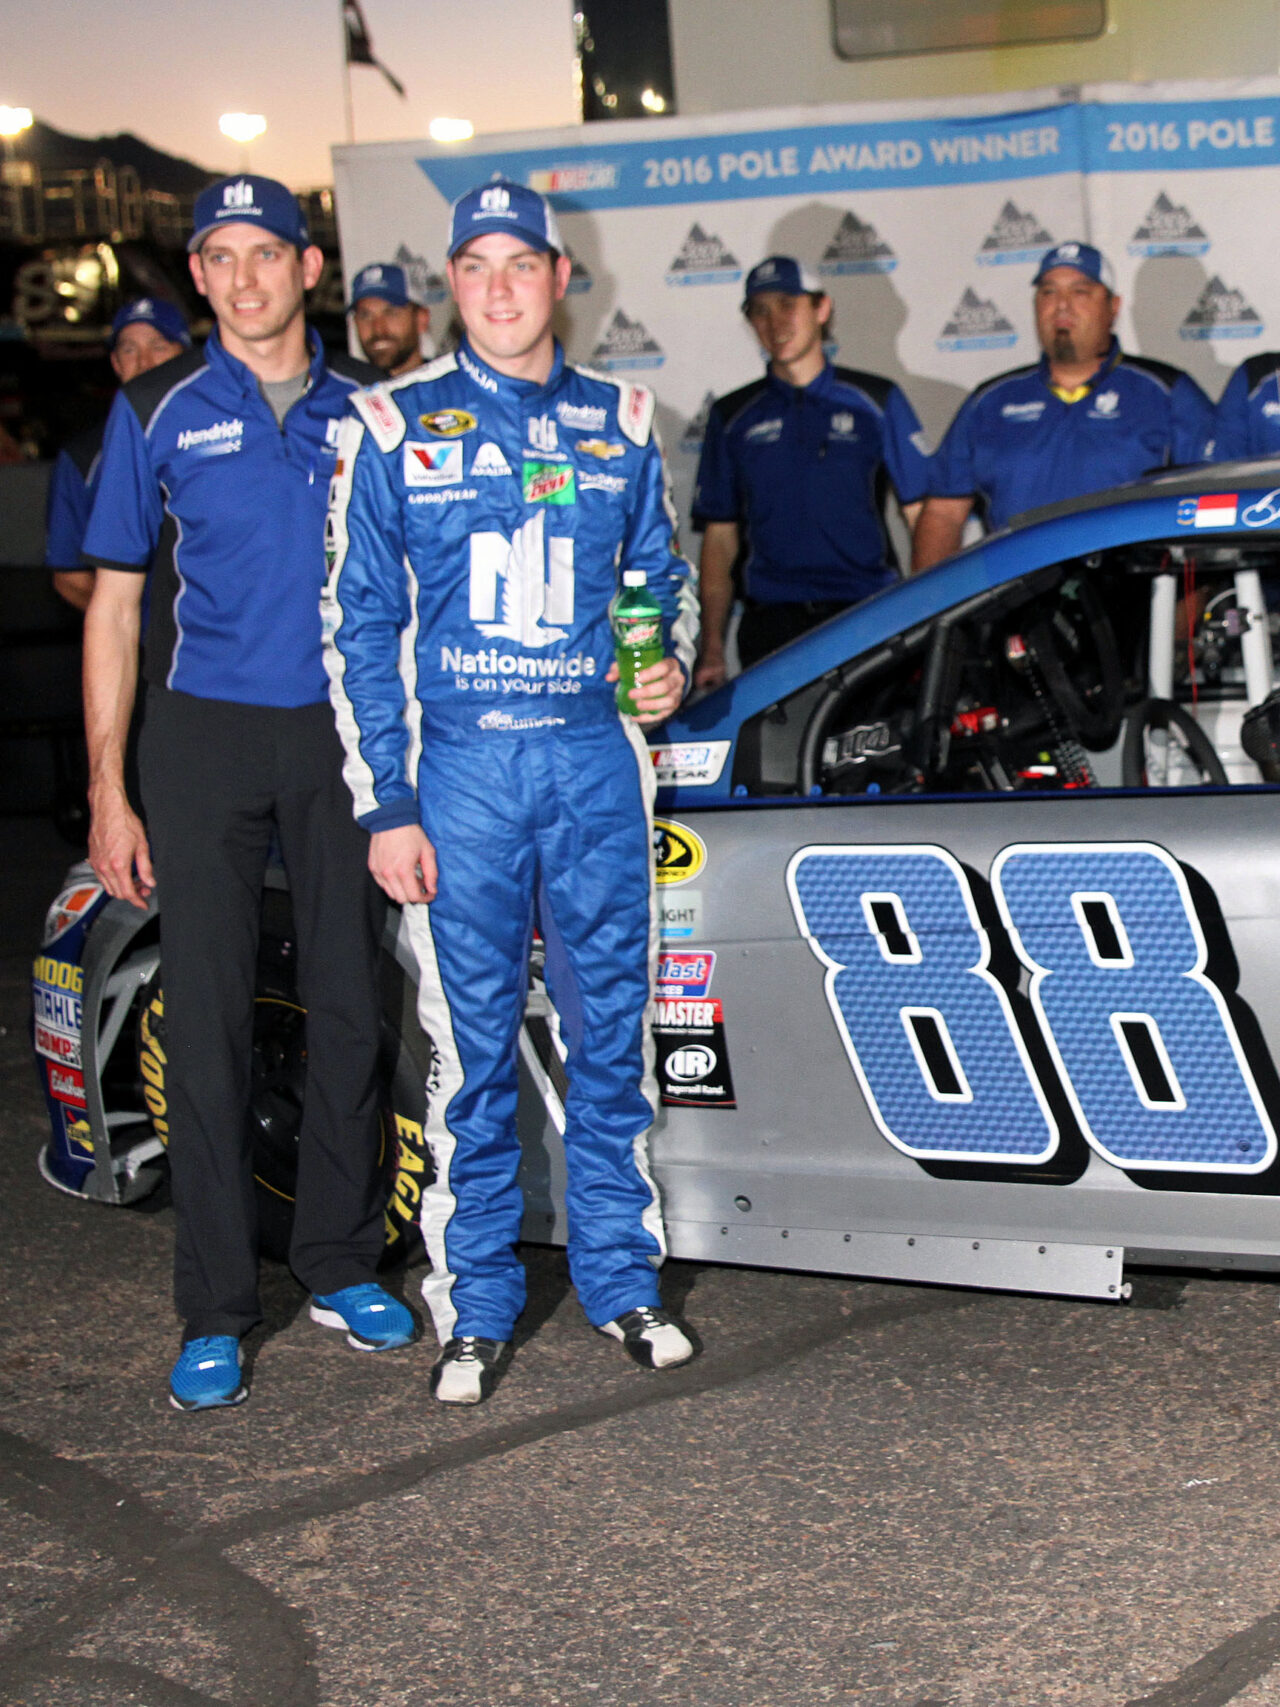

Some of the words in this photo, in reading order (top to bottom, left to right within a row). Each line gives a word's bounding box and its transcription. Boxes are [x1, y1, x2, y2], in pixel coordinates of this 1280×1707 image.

[1107, 121, 1181, 152] 2016
[1187, 116, 1275, 150] POLE
[643, 156, 713, 188] 2016
[718, 146, 800, 182] POLE
[808, 138, 924, 174] AWARD
[930, 126, 1060, 166] WINNER
[177, 418, 244, 450] Hendrick
[407, 488, 478, 505] GOODYEAR
[440, 646, 596, 678] Nationwide
[455, 674, 470, 691] is
[473, 677, 497, 692] on
[501, 678, 545, 695] your
[547, 678, 582, 694] side
[33, 954, 85, 993] MOOG
